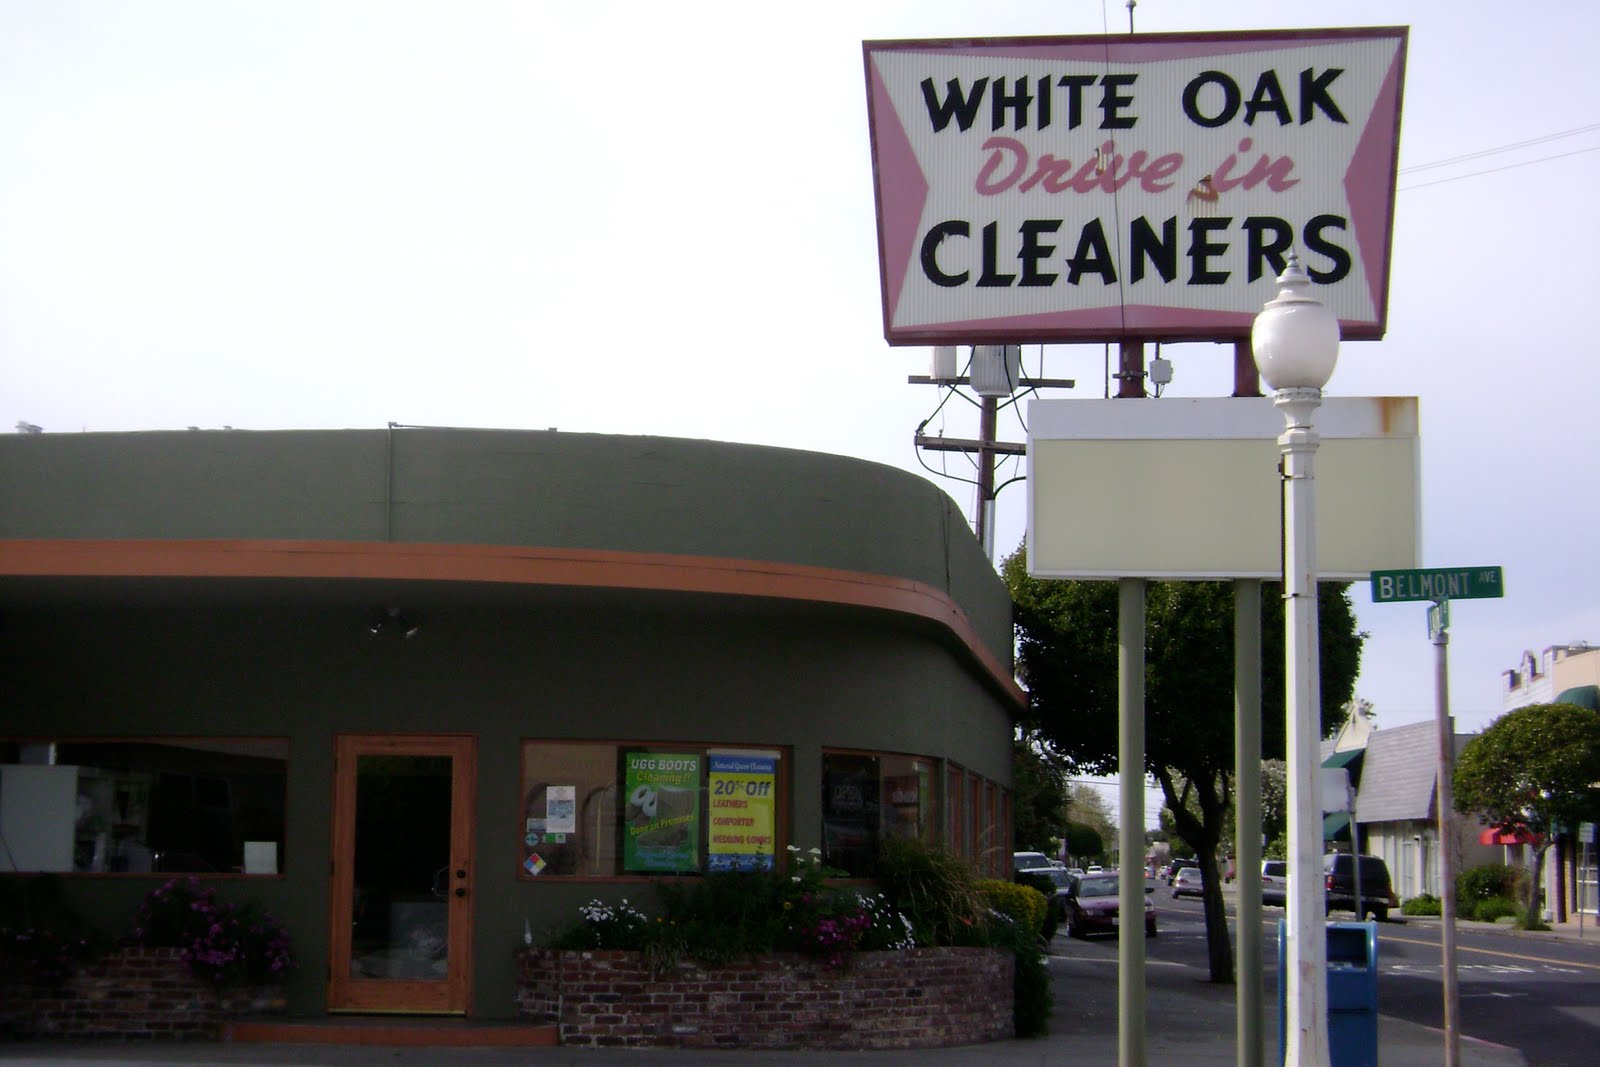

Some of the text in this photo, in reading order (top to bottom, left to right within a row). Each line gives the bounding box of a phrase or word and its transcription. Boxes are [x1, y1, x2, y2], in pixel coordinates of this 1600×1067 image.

[920, 66, 1349, 133] WHITE OAK
[975, 136, 1300, 196] Drive in
[920, 214, 1352, 288] CLEANERS
[1379, 571, 1496, 598] BELMONT AVE
[631, 758, 697, 771] UGG BOOTS
[636, 771, 681, 784] Cleaning
[714, 779, 771, 797] 20% Off
